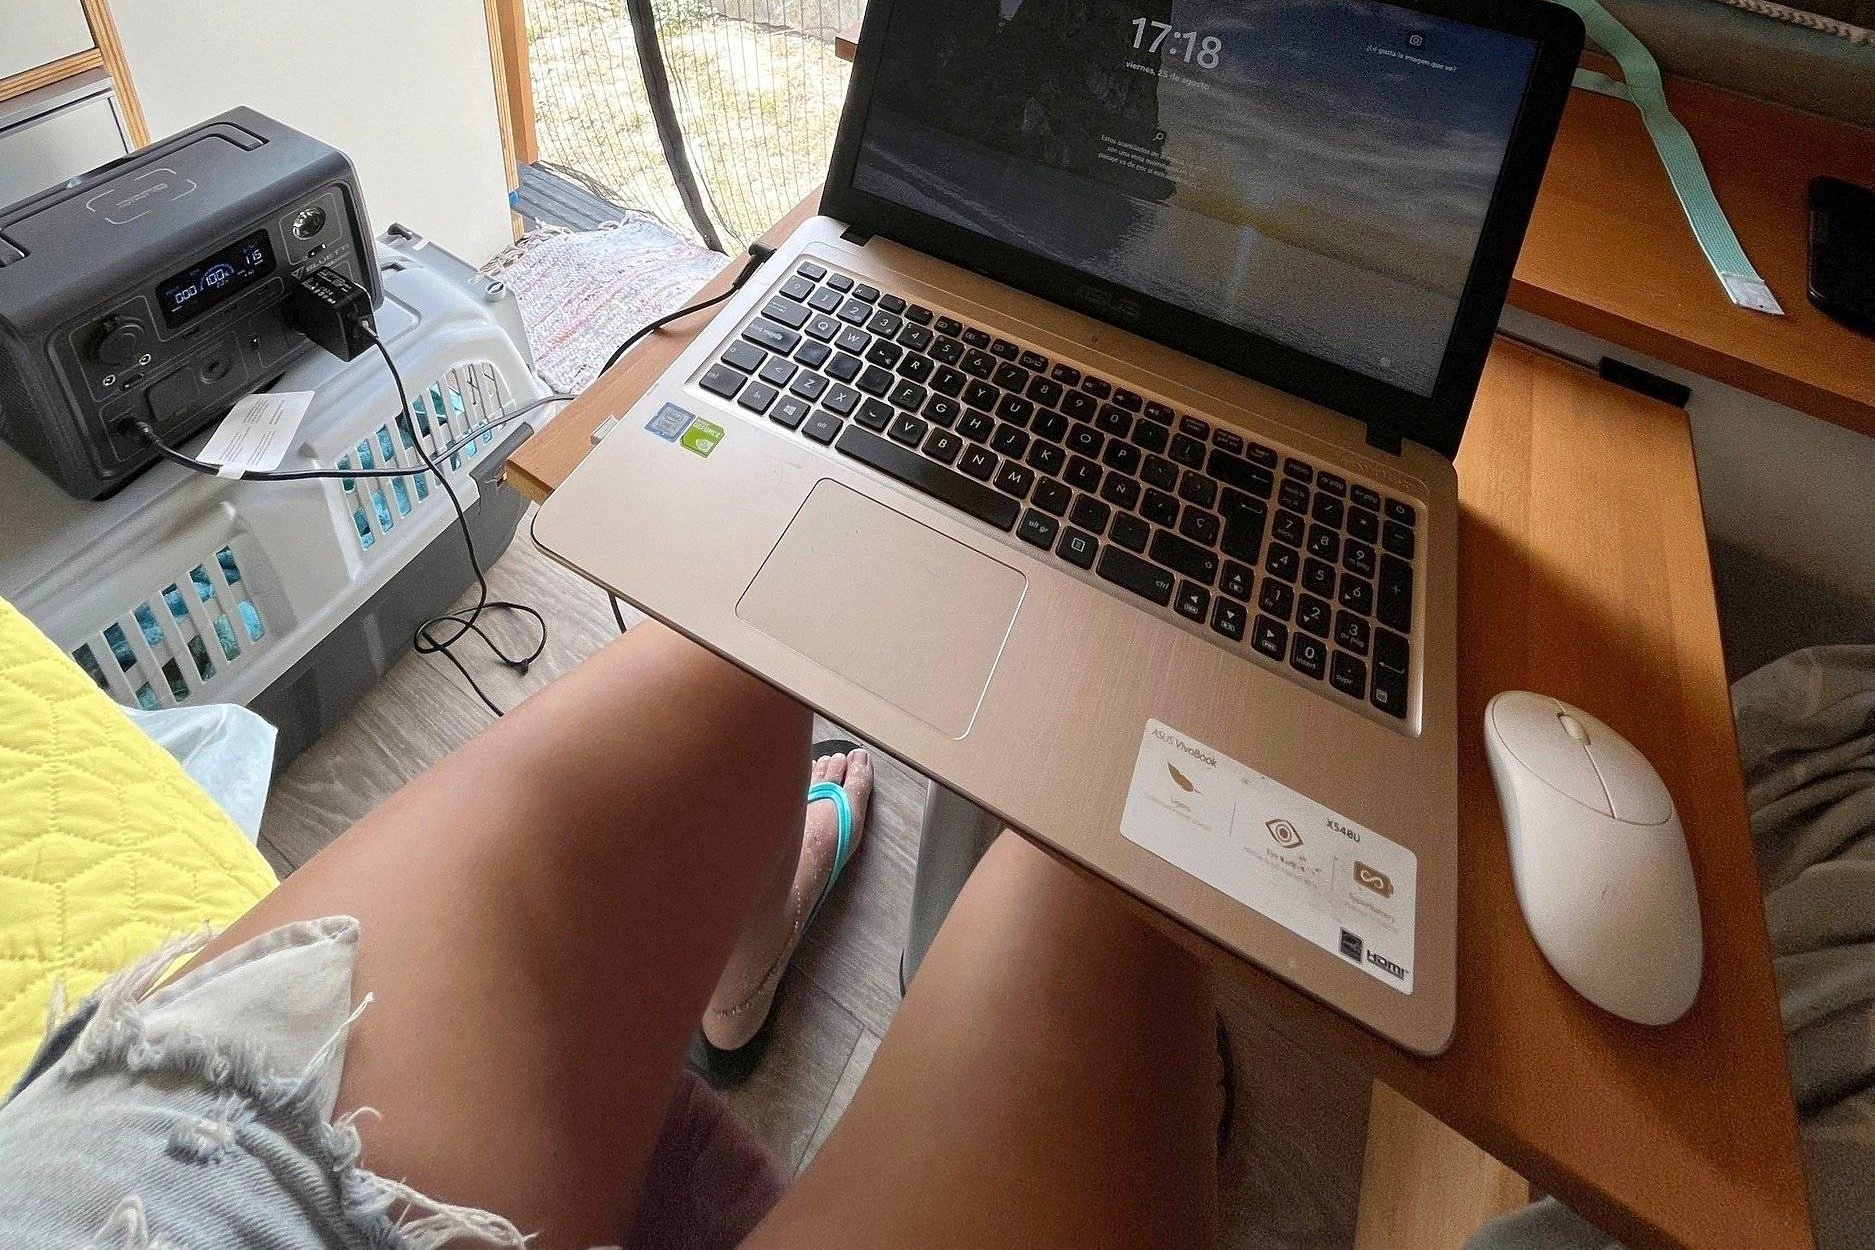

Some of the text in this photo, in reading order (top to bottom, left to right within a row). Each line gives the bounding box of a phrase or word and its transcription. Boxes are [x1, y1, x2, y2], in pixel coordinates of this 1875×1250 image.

[1132, 17, 1222, 69] 17:18
[1125, 60, 1156, 76] viernes,
[306, 244, 349, 272] BLUETTI
[817, 321, 828, 331] Q
[847, 333, 859, 342] W
[911, 361, 920, 370] R
[974, 358, 982, 366] 6
[804, 378, 816, 389] Z
[977, 388, 986, 397] Y
[1040, 385, 1049, 393] 8
[836, 392, 847, 403] X
[936, 403, 947, 412] G
[1010, 403, 1020, 412] U
[904, 422, 914, 431] V
[970, 418, 981, 428] H
[938, 438, 948, 448] B
[1006, 435, 1015, 444] J
[1041, 450, 1051, 460] K
[1118, 450, 1127, 458] P
[972, 455, 984, 465] N
[1080, 466, 1087, 477] L
[1008, 471, 1022, 483] M
[1286, 519, 1293, 529] 7
[1320, 536, 1329, 546] 8
[1356, 550, 1364, 559] 9
[1280, 555, 1289, 565] 4
[1316, 570, 1325, 581] 5
[1353, 587, 1361, 597] 6
[1311, 607, 1320, 619] 2
[1349, 625, 1358, 636] 3
[1175, 738, 1217, 768] VivoBook
[1366, 949, 1404, 980] HDMI
